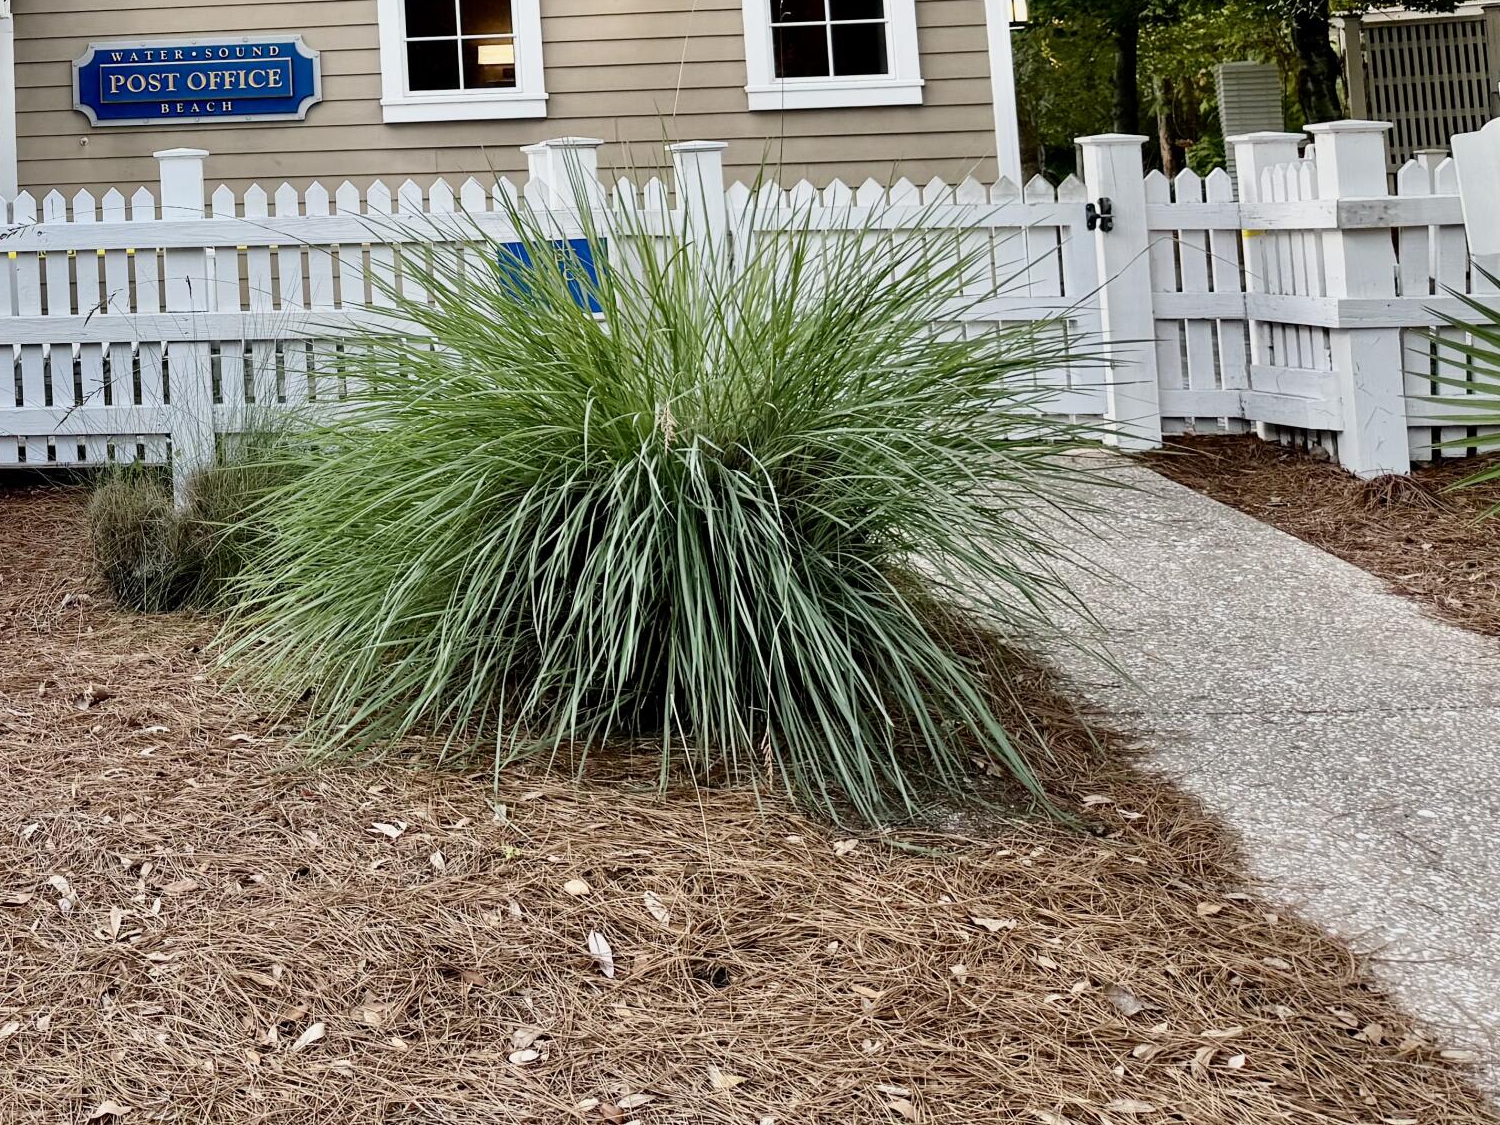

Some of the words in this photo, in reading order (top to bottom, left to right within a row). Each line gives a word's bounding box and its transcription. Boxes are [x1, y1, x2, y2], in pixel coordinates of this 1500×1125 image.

[111, 49, 184, 63] WATER
[205, 45, 280, 59] SOUND
[108, 72, 180, 94] POST
[187, 68, 283, 92] OFFICE
[160, 101, 233, 114] BEACH
